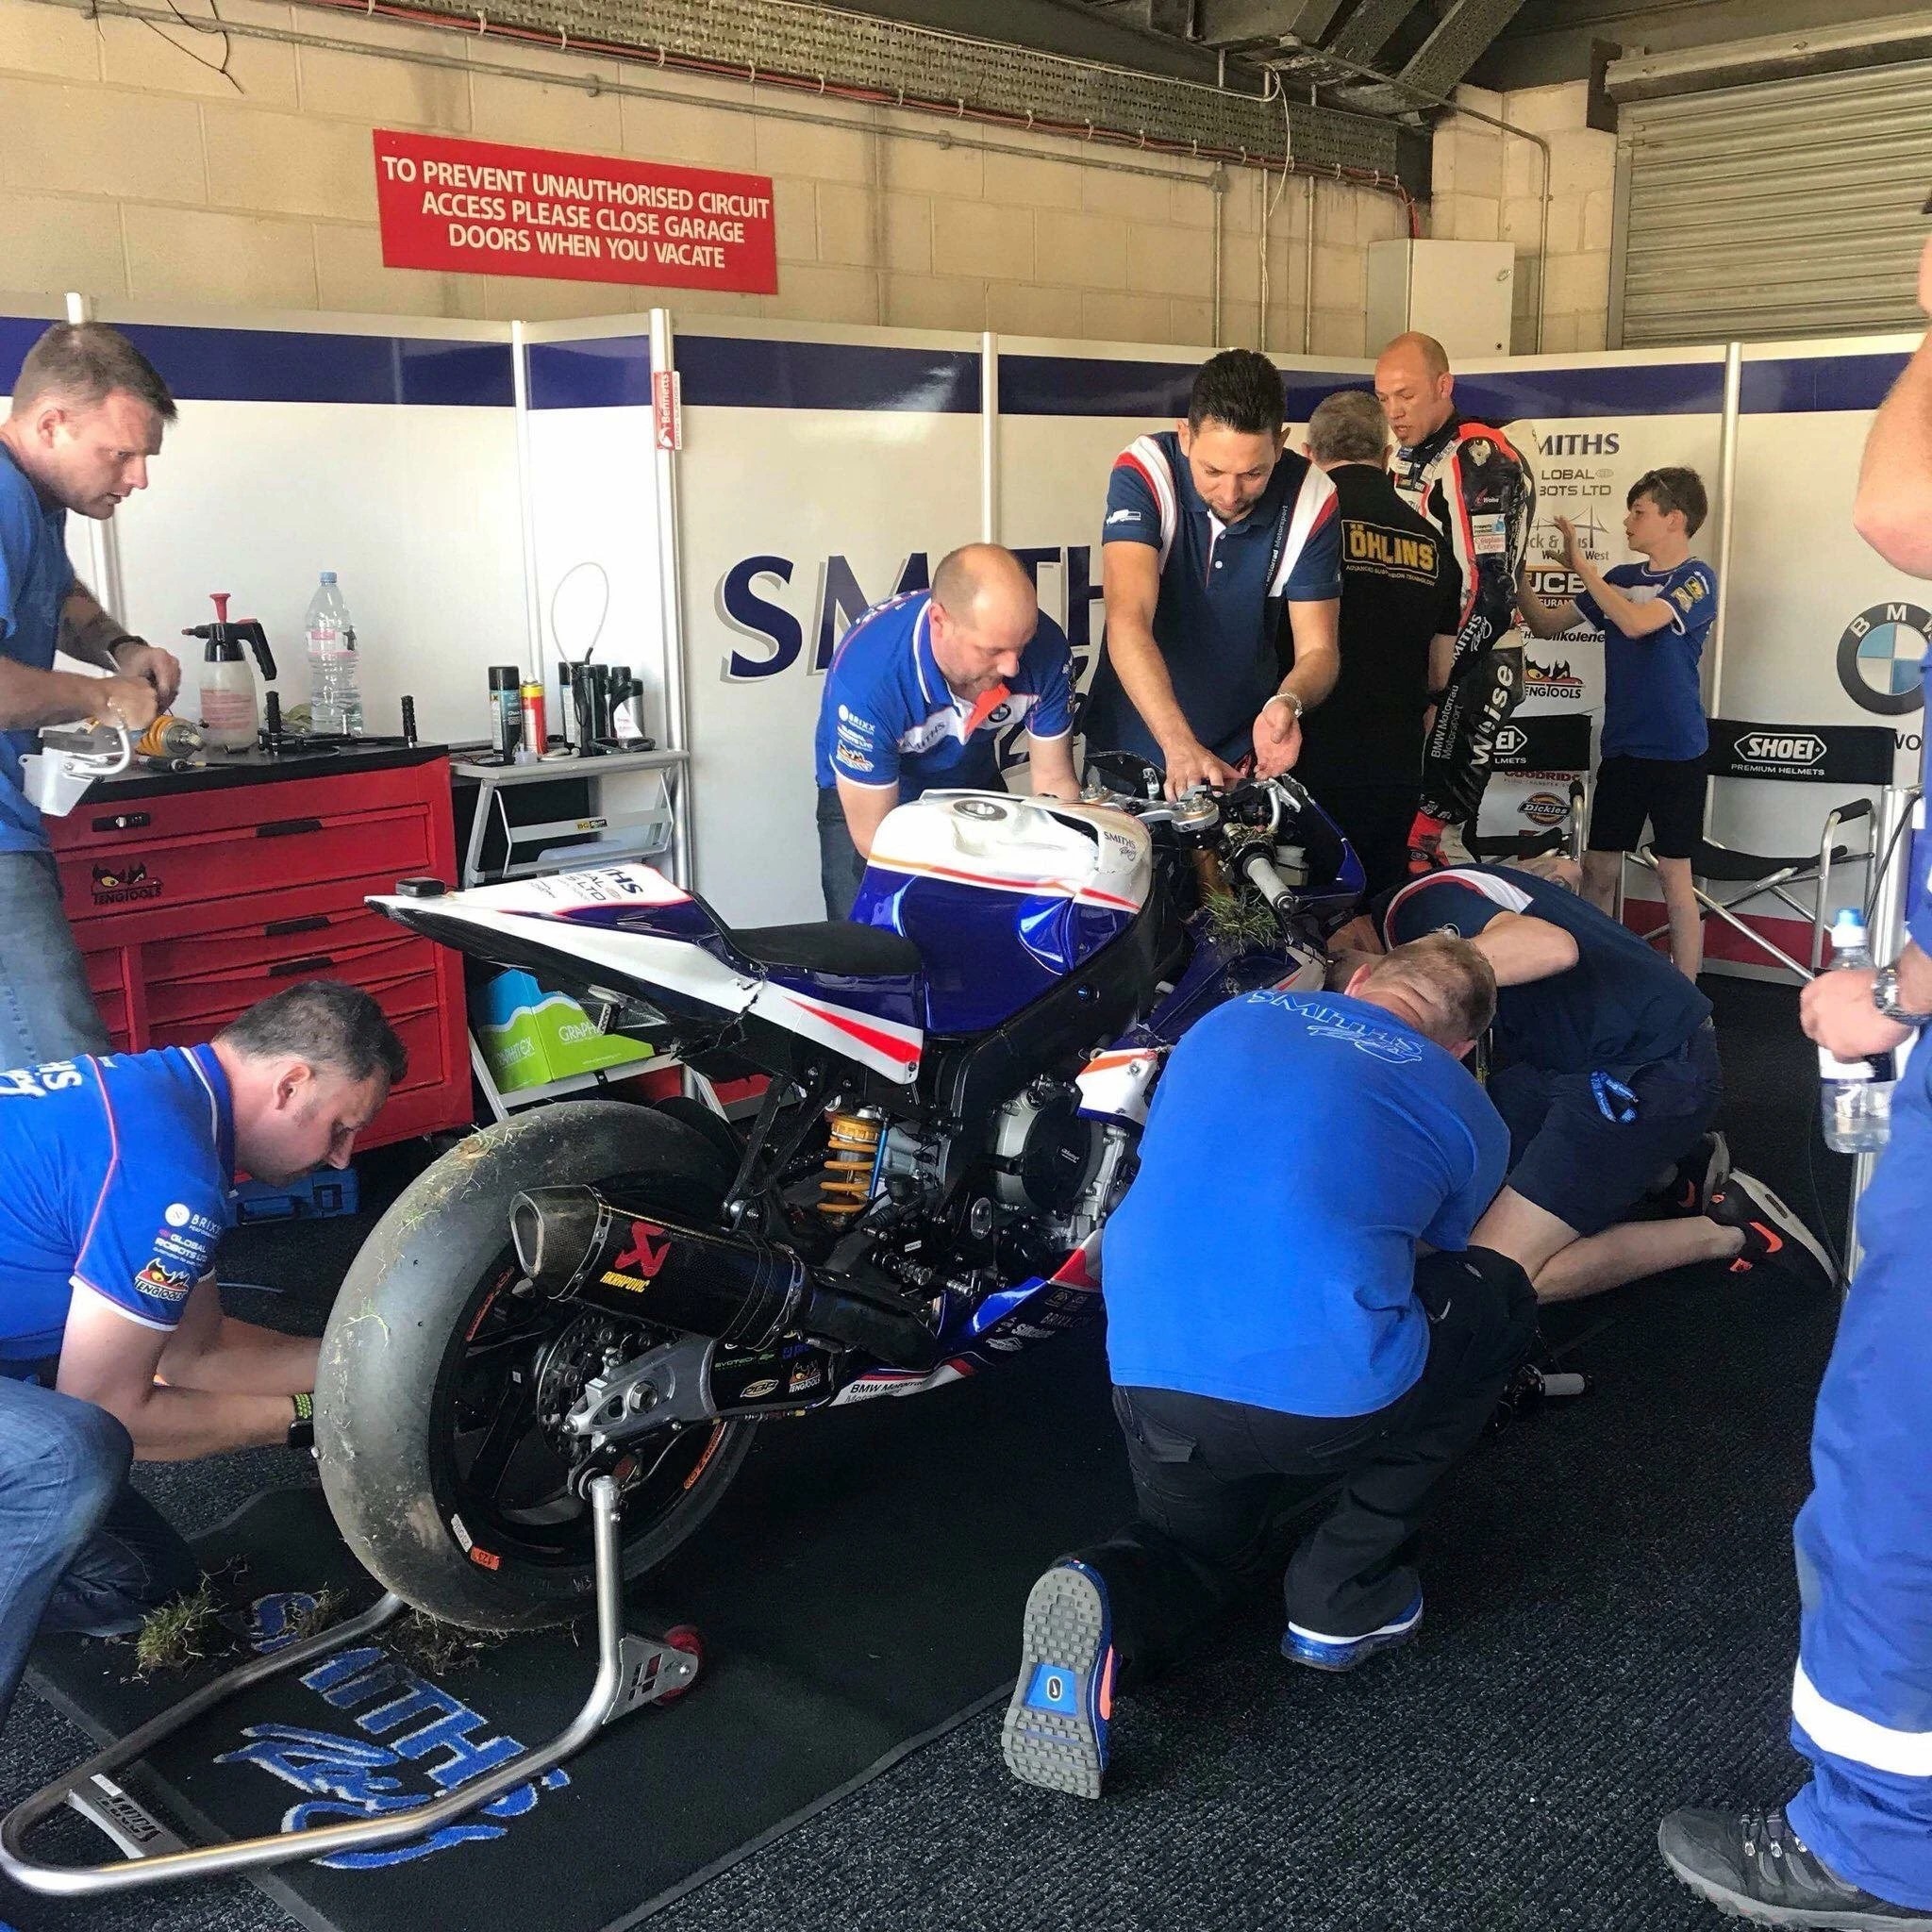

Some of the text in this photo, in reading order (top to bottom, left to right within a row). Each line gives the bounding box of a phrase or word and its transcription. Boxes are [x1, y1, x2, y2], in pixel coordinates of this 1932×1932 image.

[381, 156, 770, 220] TO PREVENT UNAUTHORISED CIRCUIT
[422, 191, 745, 244] ACCESS PLEASE CLOSE GARAGE
[449, 225, 725, 269] DOORS WHEN YOU VACATE
[1582, 484, 1611, 495] LTD
[1349, 523, 1434, 572] ÖHLINS
[1585, 550, 1609, 560] West
[1529, 572, 1587, 592] JCB
[1430, 730, 1446, 758] BMW
[1747, 737, 1816, 759] SHOEI
[1731, 763, 1825, 775] PREMIUM HELMETS
[1524, 803, 1568, 814] Dickies
[1104, 831, 1136, 849] SMITHS
[1247, 991, 1425, 1057] SMITHS
[154, 1237, 198, 1260] ROBOTS
[171, 1233, 207, 1254] GLOBAL
[850, 1384, 881, 1393] BMW
